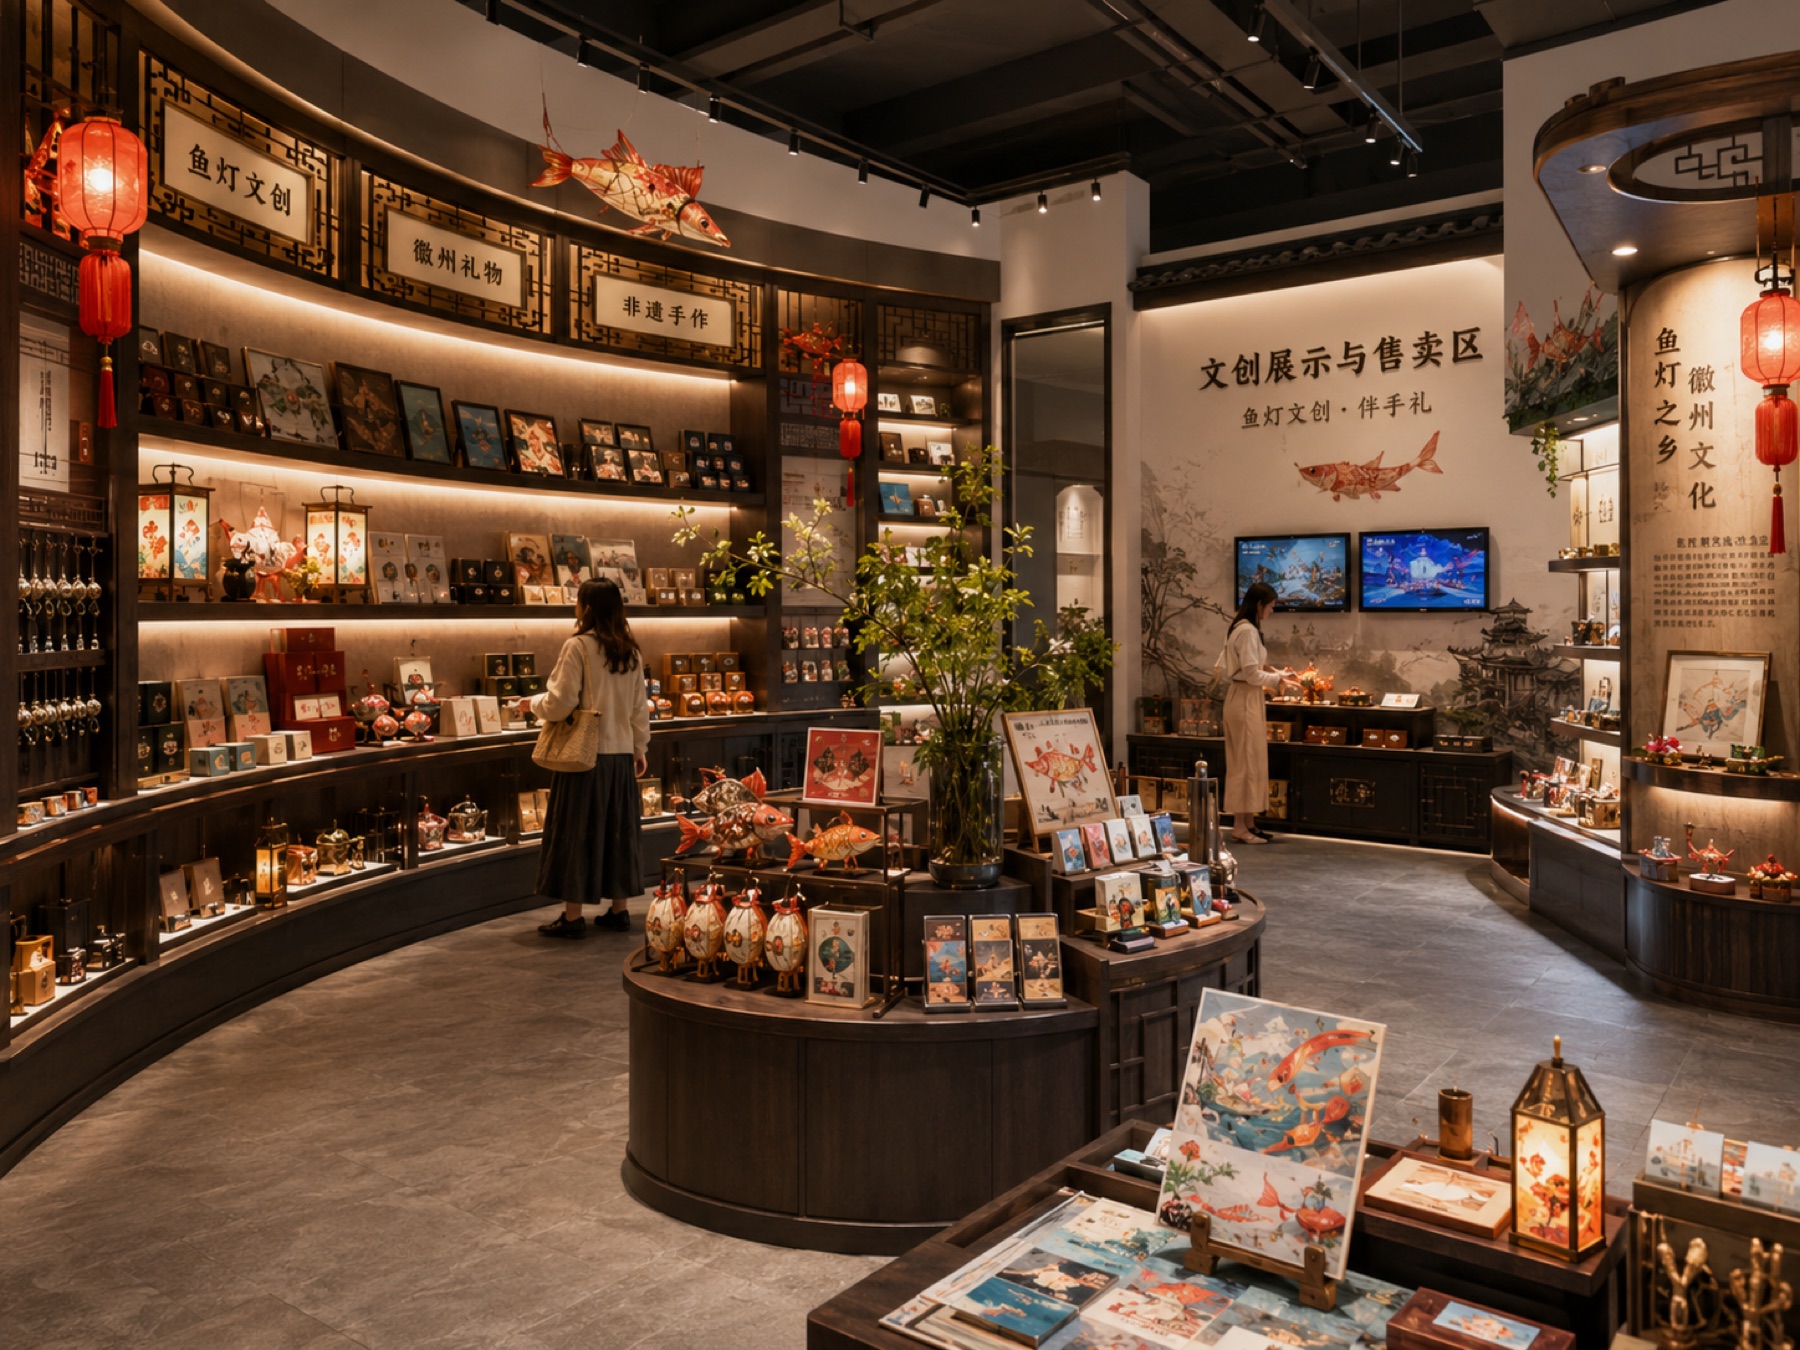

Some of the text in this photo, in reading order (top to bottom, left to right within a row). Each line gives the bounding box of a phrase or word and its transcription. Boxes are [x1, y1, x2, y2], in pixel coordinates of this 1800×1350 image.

[187, 143, 292, 217] 鱼灯文创
[413, 238, 503, 286] 徽州礼物
[1199, 326, 1484, 391] 文创展示与售卖区
[1241, 391, 1433, 429] 鱼灯文创·伴手礼
[1653, 326, 1682, 465] 鱼灯之乡
[1687, 364, 1717, 511] 徽州文化
